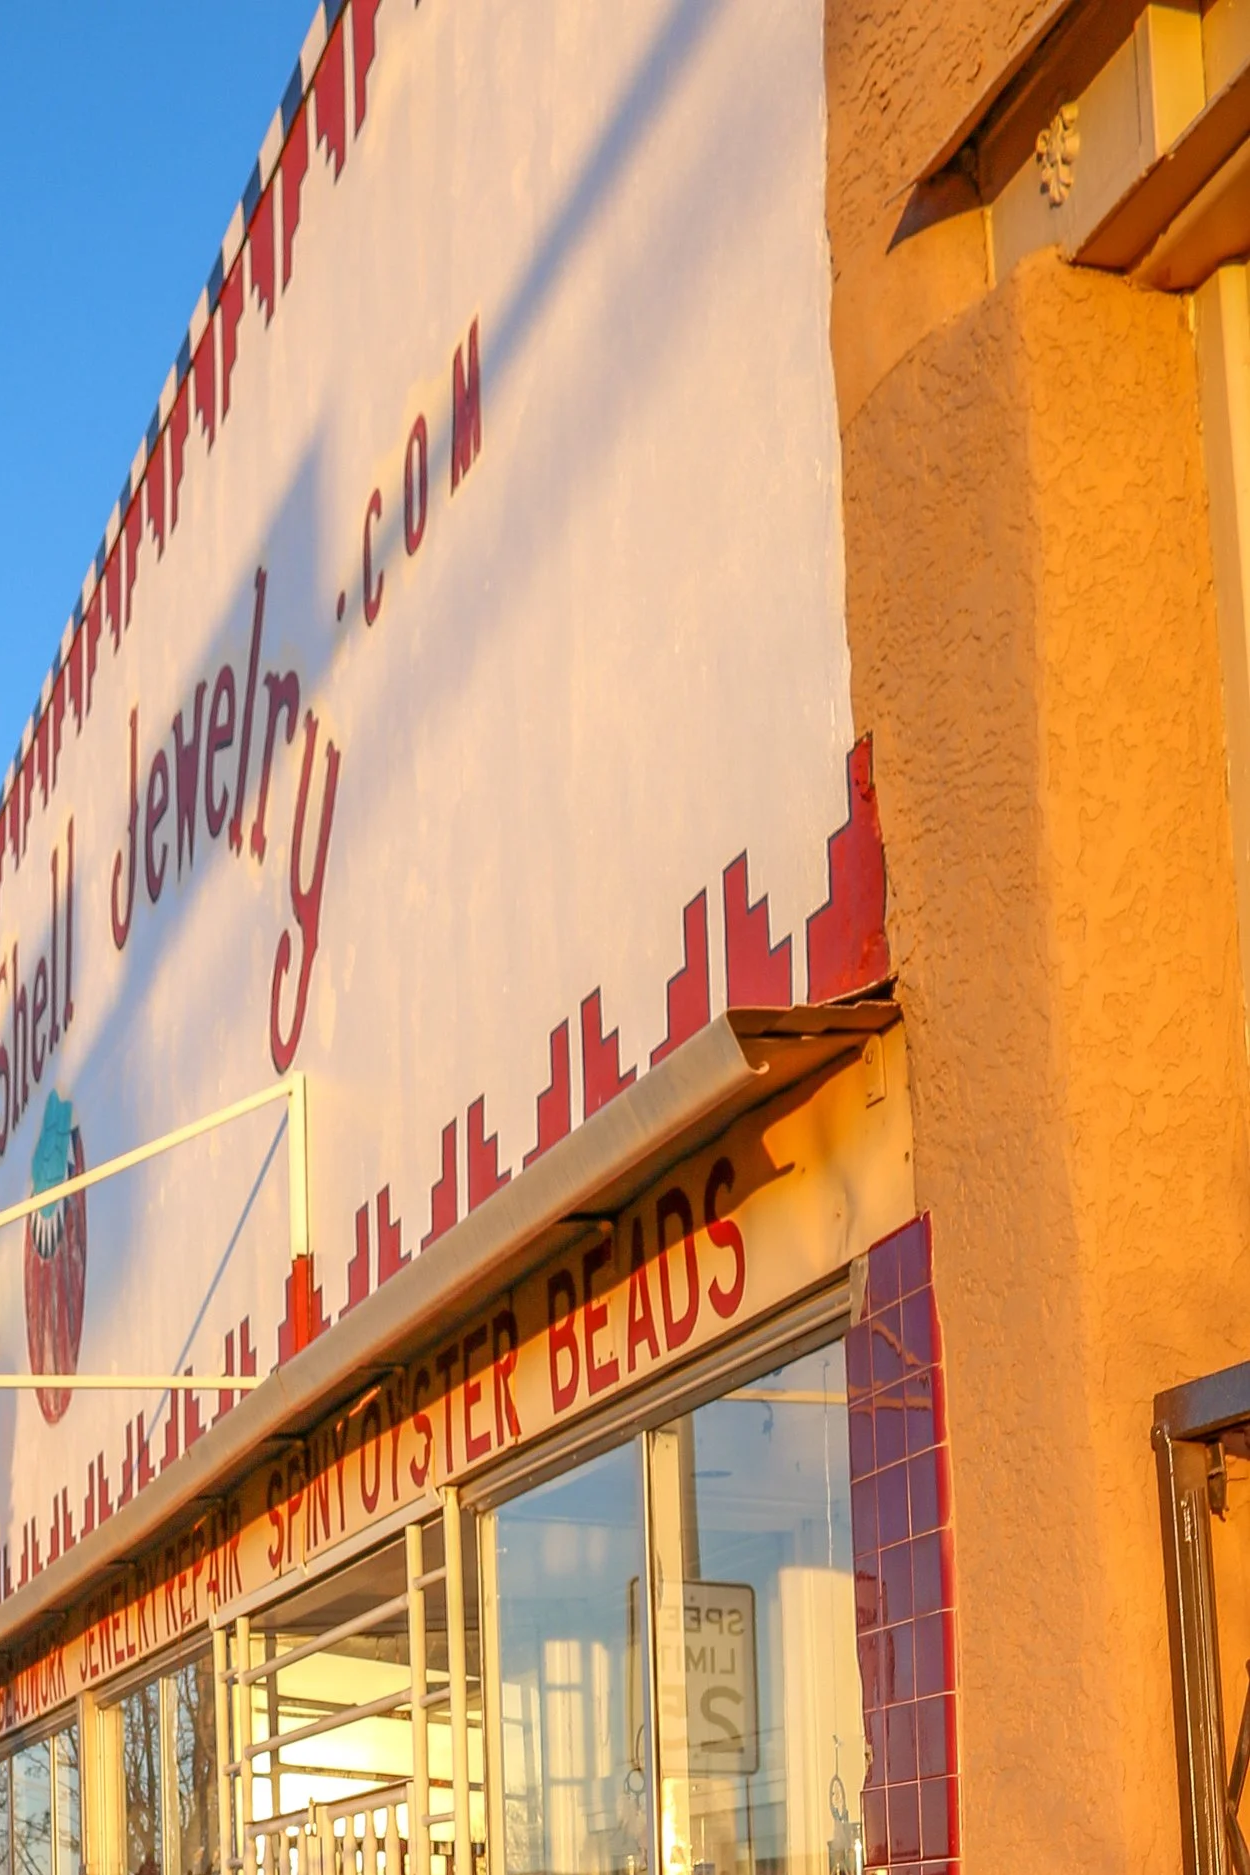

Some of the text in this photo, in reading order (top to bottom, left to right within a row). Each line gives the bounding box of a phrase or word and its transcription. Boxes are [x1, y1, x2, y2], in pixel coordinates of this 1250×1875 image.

[111, 565, 341, 1075] Jewelry
[79, 1557, 158, 1684] JEWELRY
[164, 1498, 243, 1638] REPAIR
[266, 1417, 348, 1573] SPINY
[360, 1308, 522, 1514] OYSTER
[547, 1157, 746, 1416] BEADS
